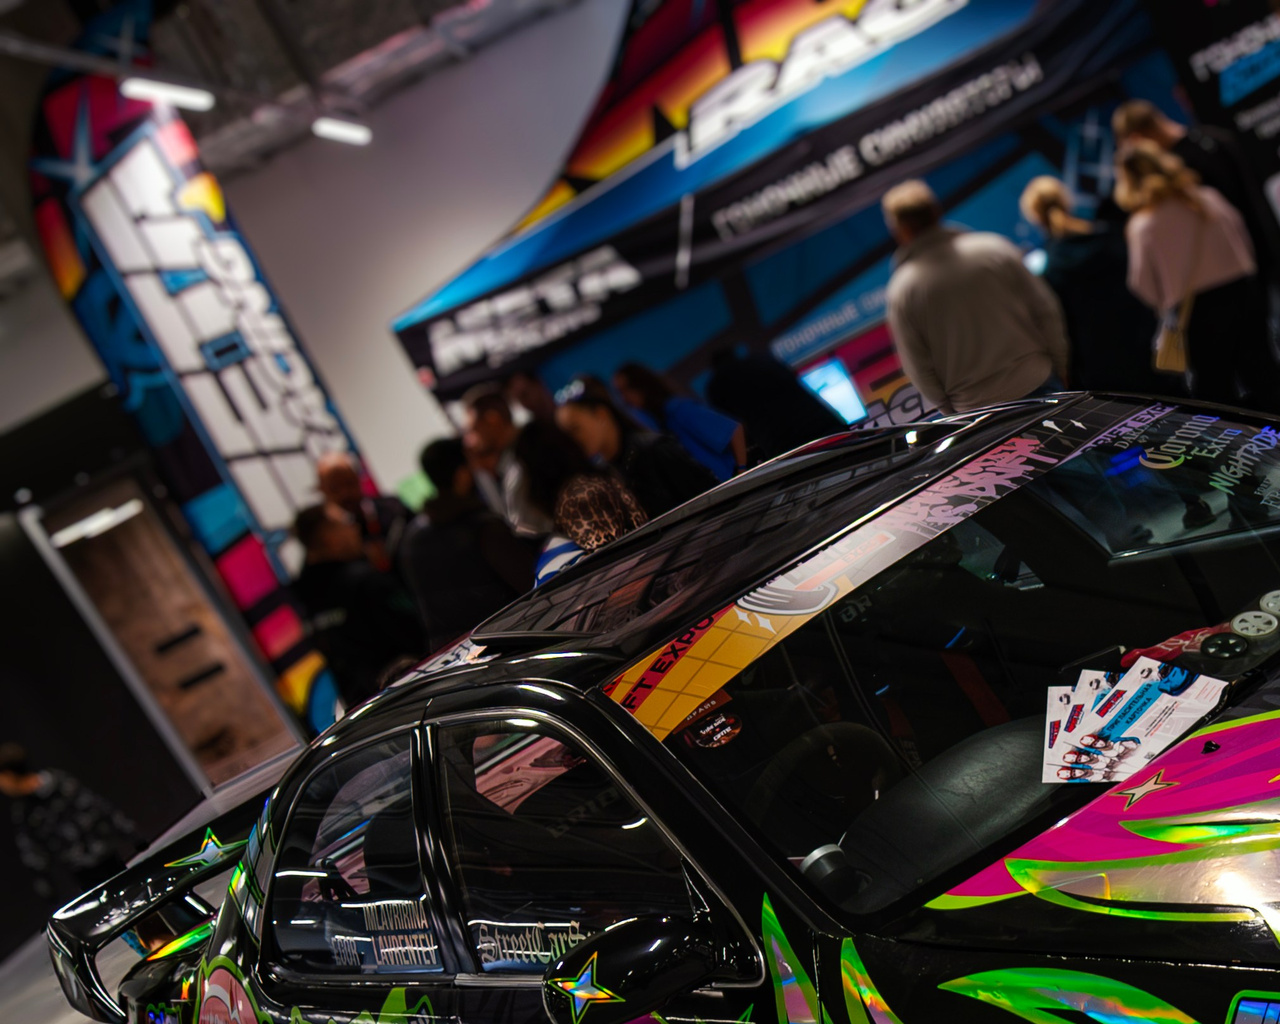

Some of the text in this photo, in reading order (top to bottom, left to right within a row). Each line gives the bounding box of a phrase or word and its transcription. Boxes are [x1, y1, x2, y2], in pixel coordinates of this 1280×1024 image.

[1139, 414, 1220, 469] Corona
[1105, 682, 1153, 733] ПРИГЛАСИТЕЛЬНАЯ
[1124, 696, 1152, 725] КАРТОЧКА
[372, 933, 438, 966] LAVRENTEV
